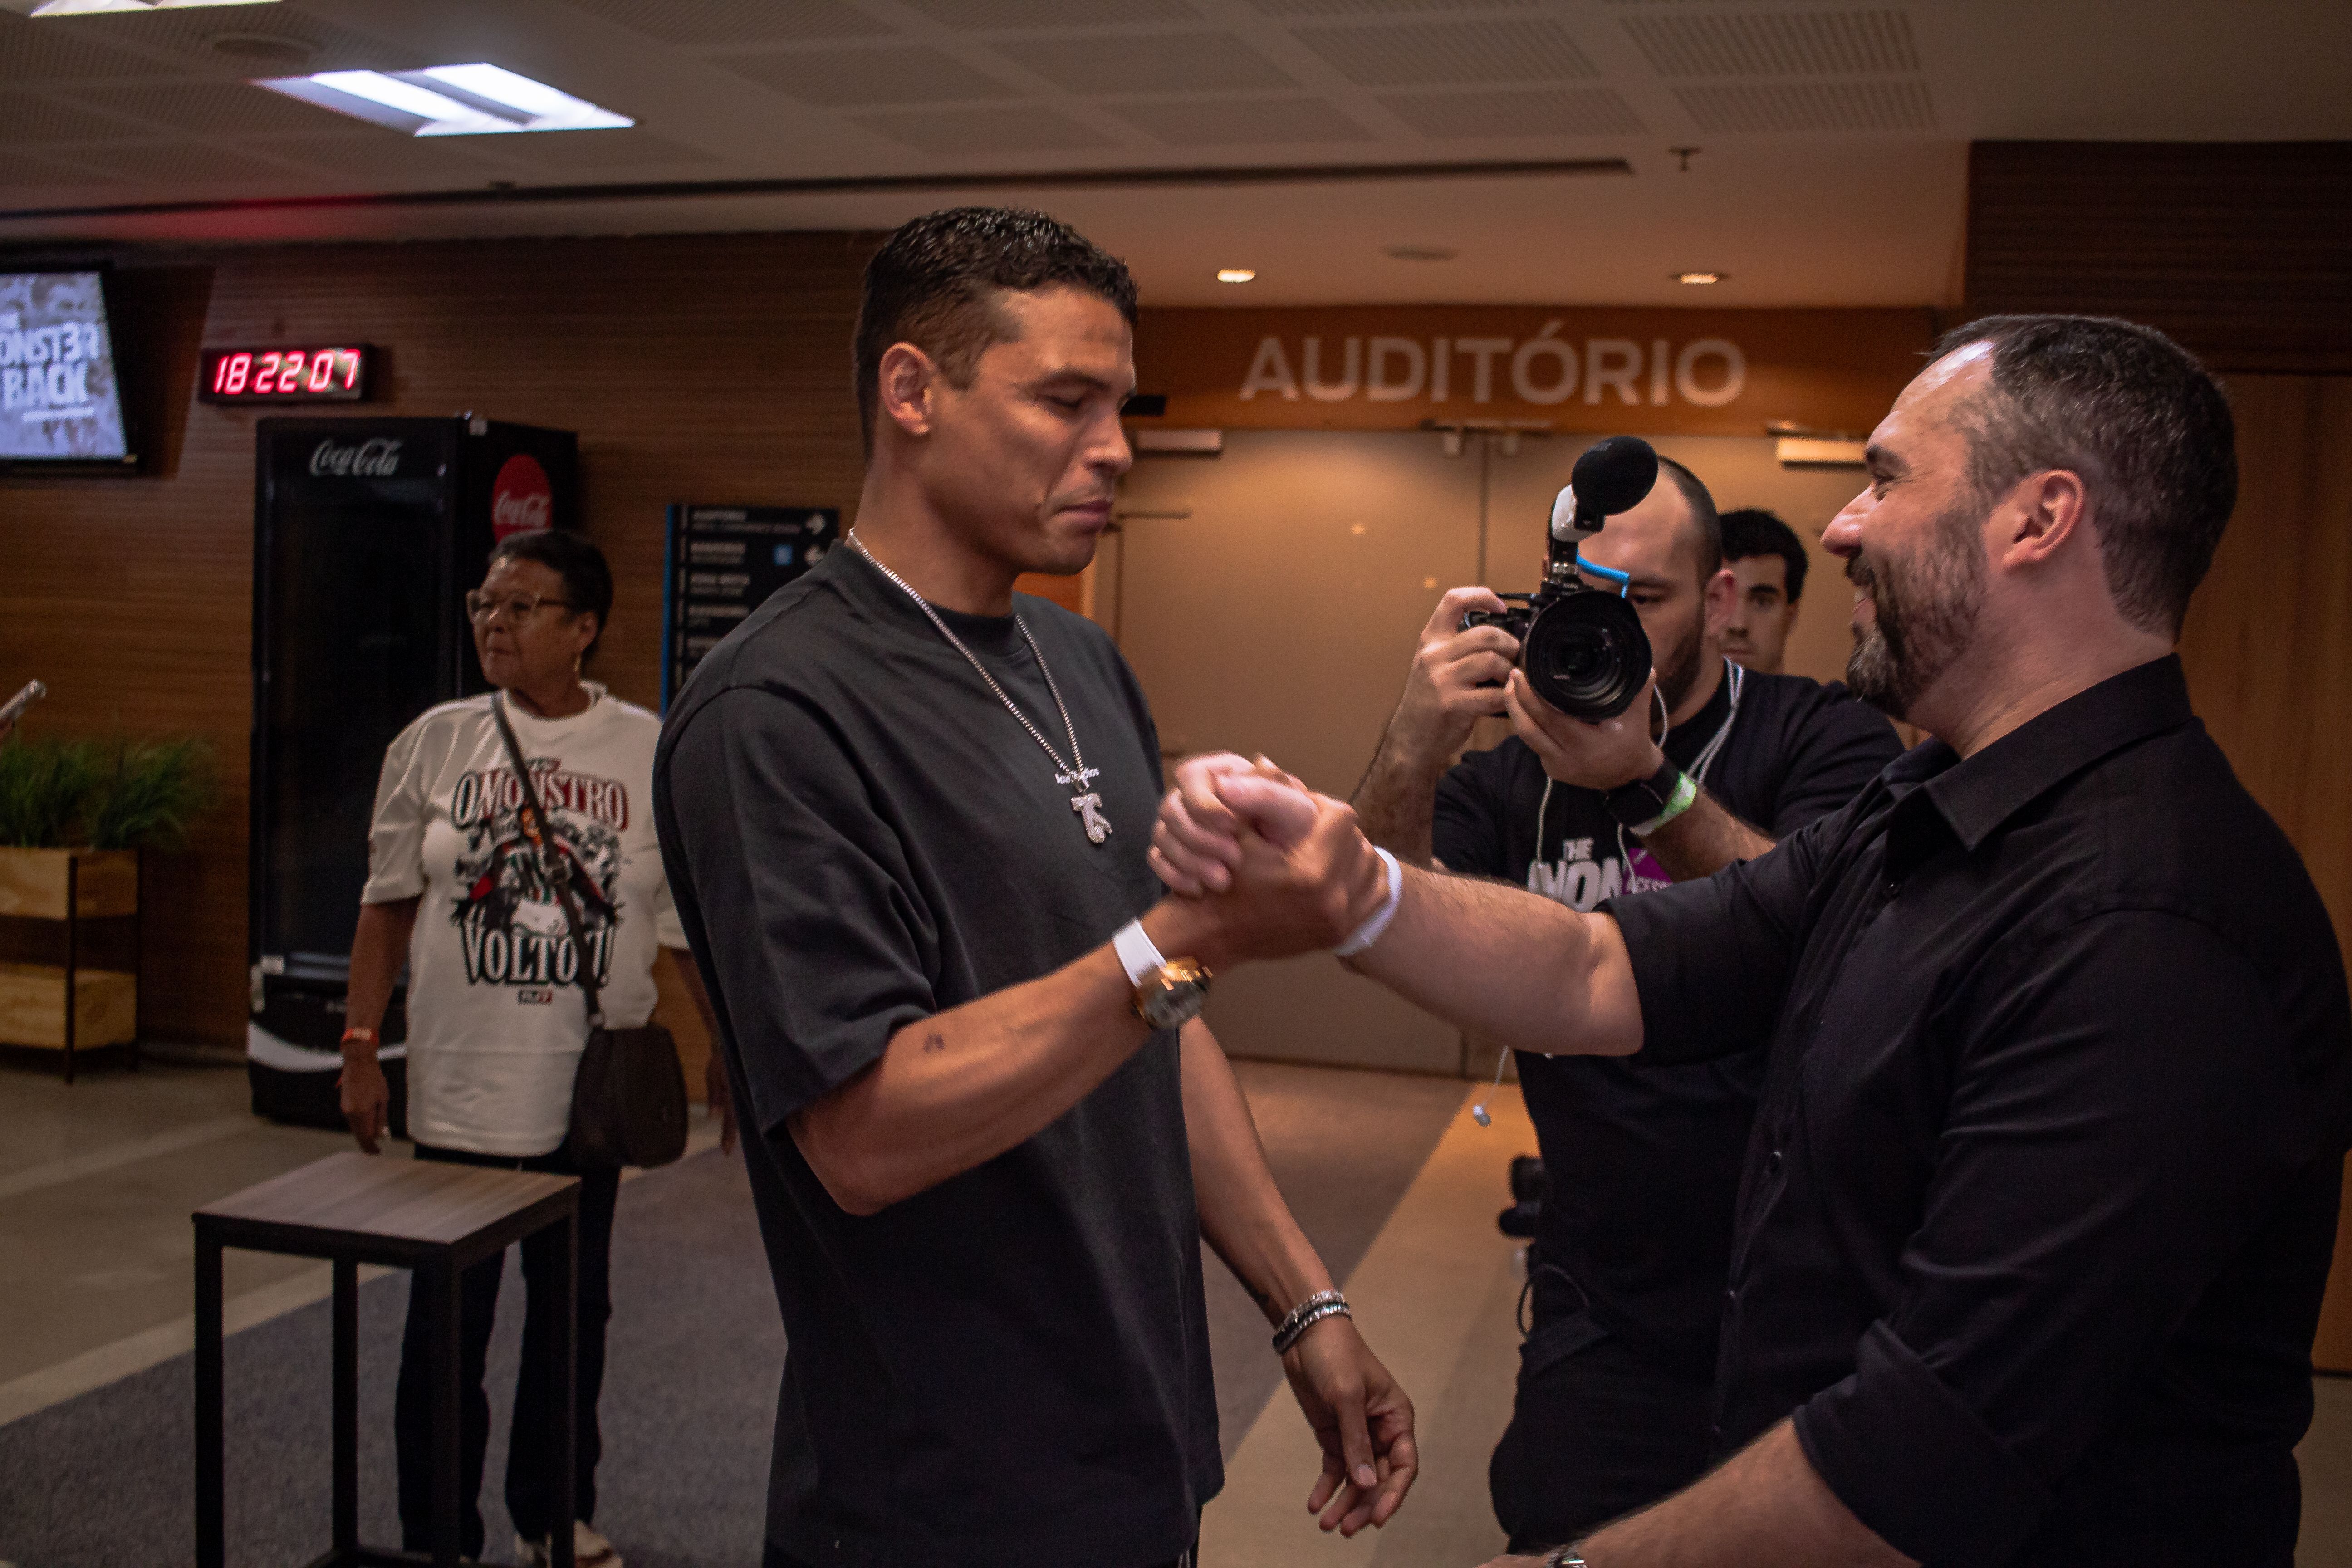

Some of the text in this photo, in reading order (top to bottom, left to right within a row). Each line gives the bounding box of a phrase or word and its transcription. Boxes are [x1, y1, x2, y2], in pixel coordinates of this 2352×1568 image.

[3, 361, 90, 411] BACK
[1238, 318, 1746, 407] AUDITÓRIO
[477, 770, 626, 830] MONSTRO
